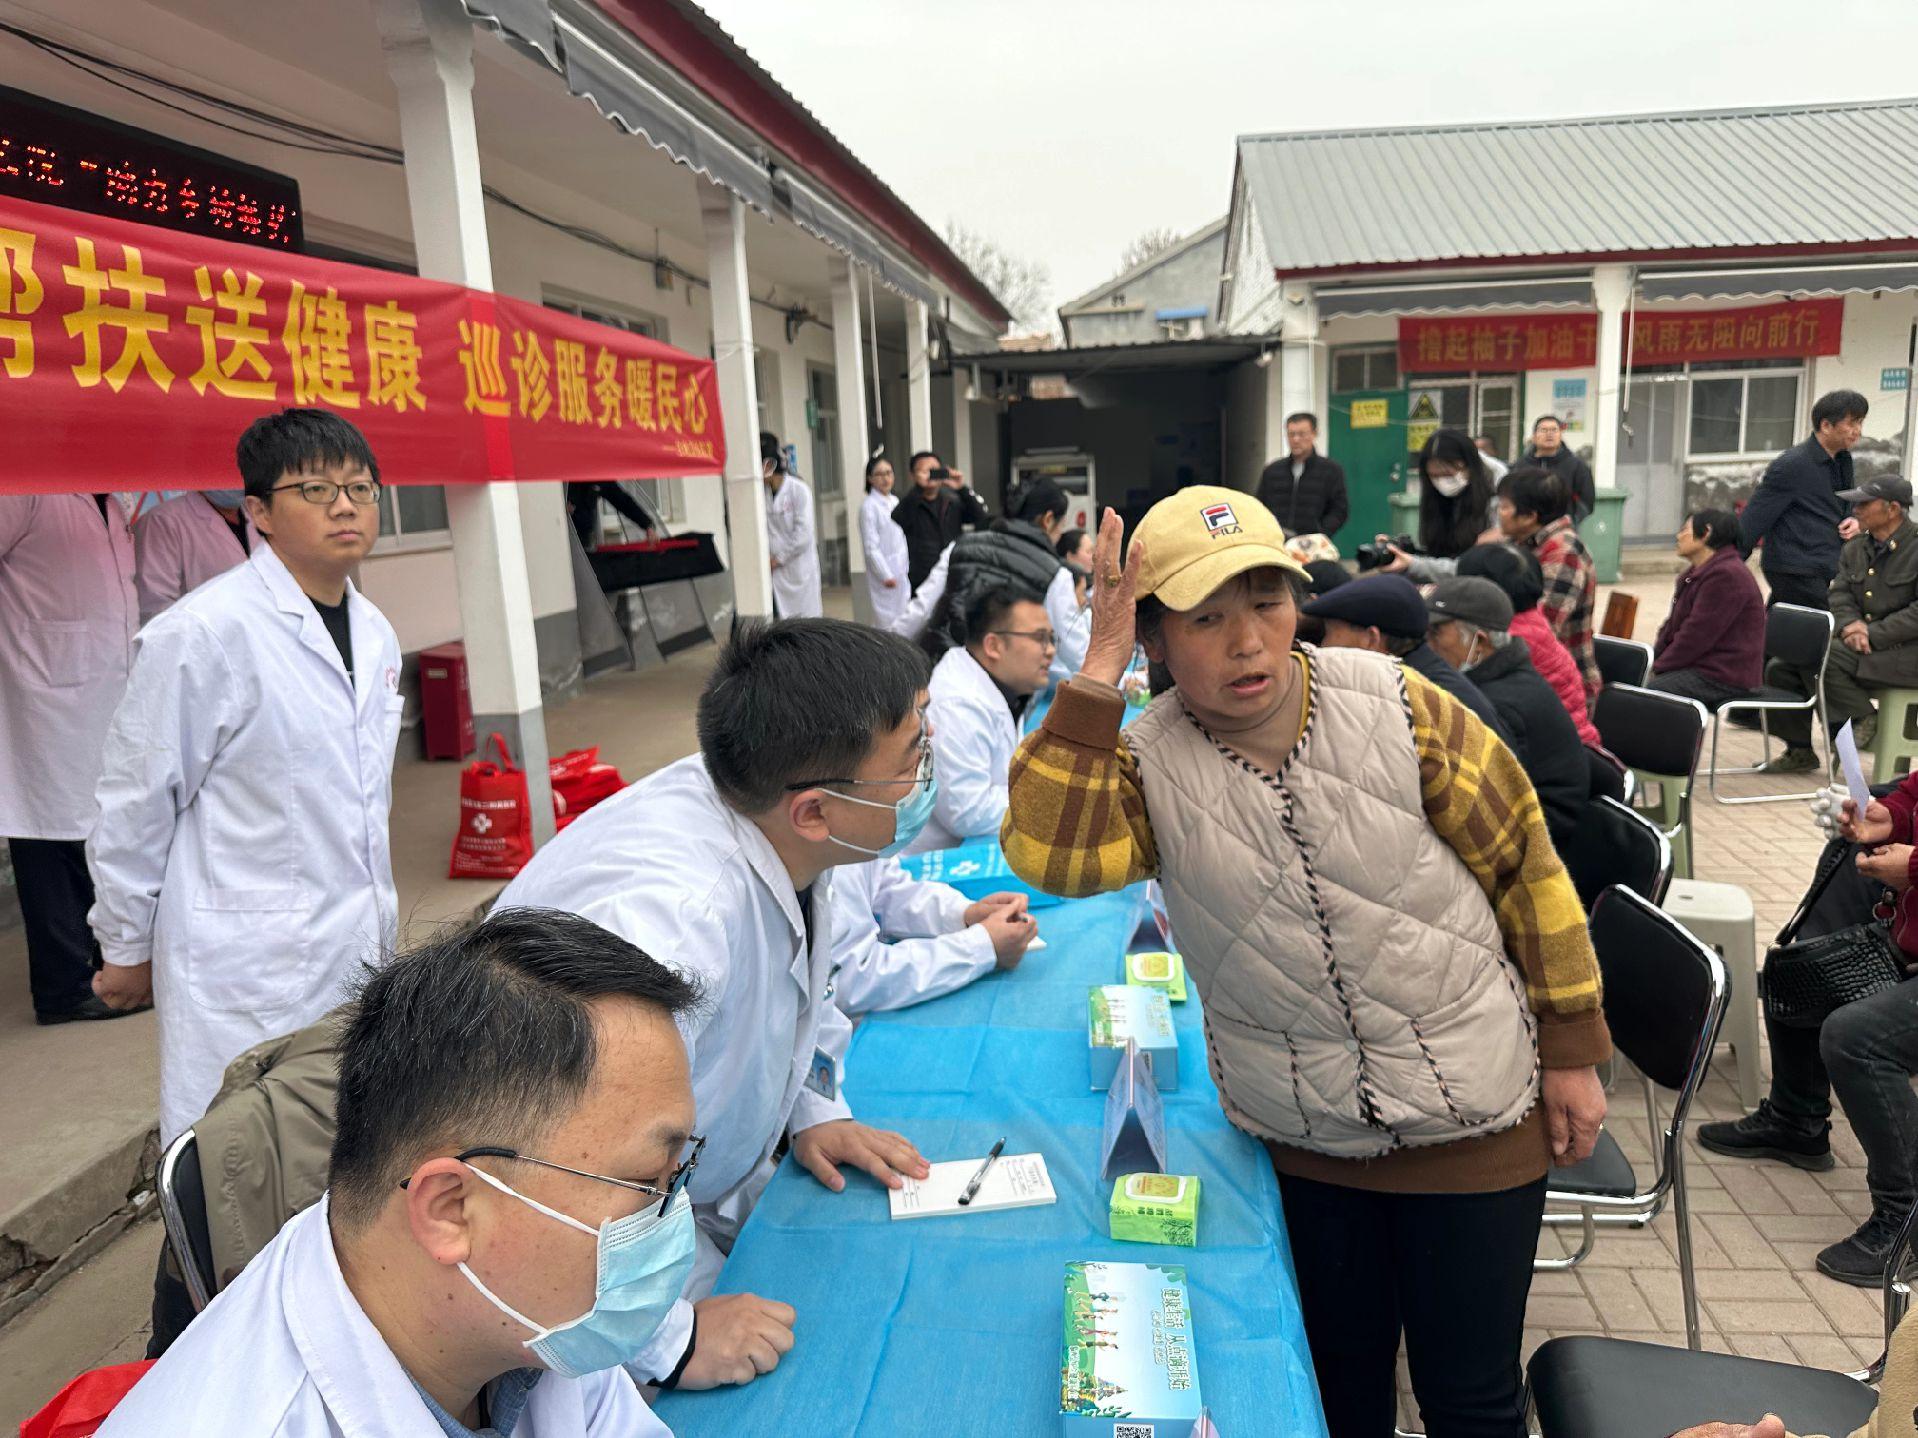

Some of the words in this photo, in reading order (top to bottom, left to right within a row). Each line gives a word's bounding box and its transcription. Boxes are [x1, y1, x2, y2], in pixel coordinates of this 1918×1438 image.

[1632, 308, 1820, 353] 风雨无阻向前行
[458, 318, 708, 435] 巡诊服务暖民心
[1210, 526, 1243, 539] FILA
